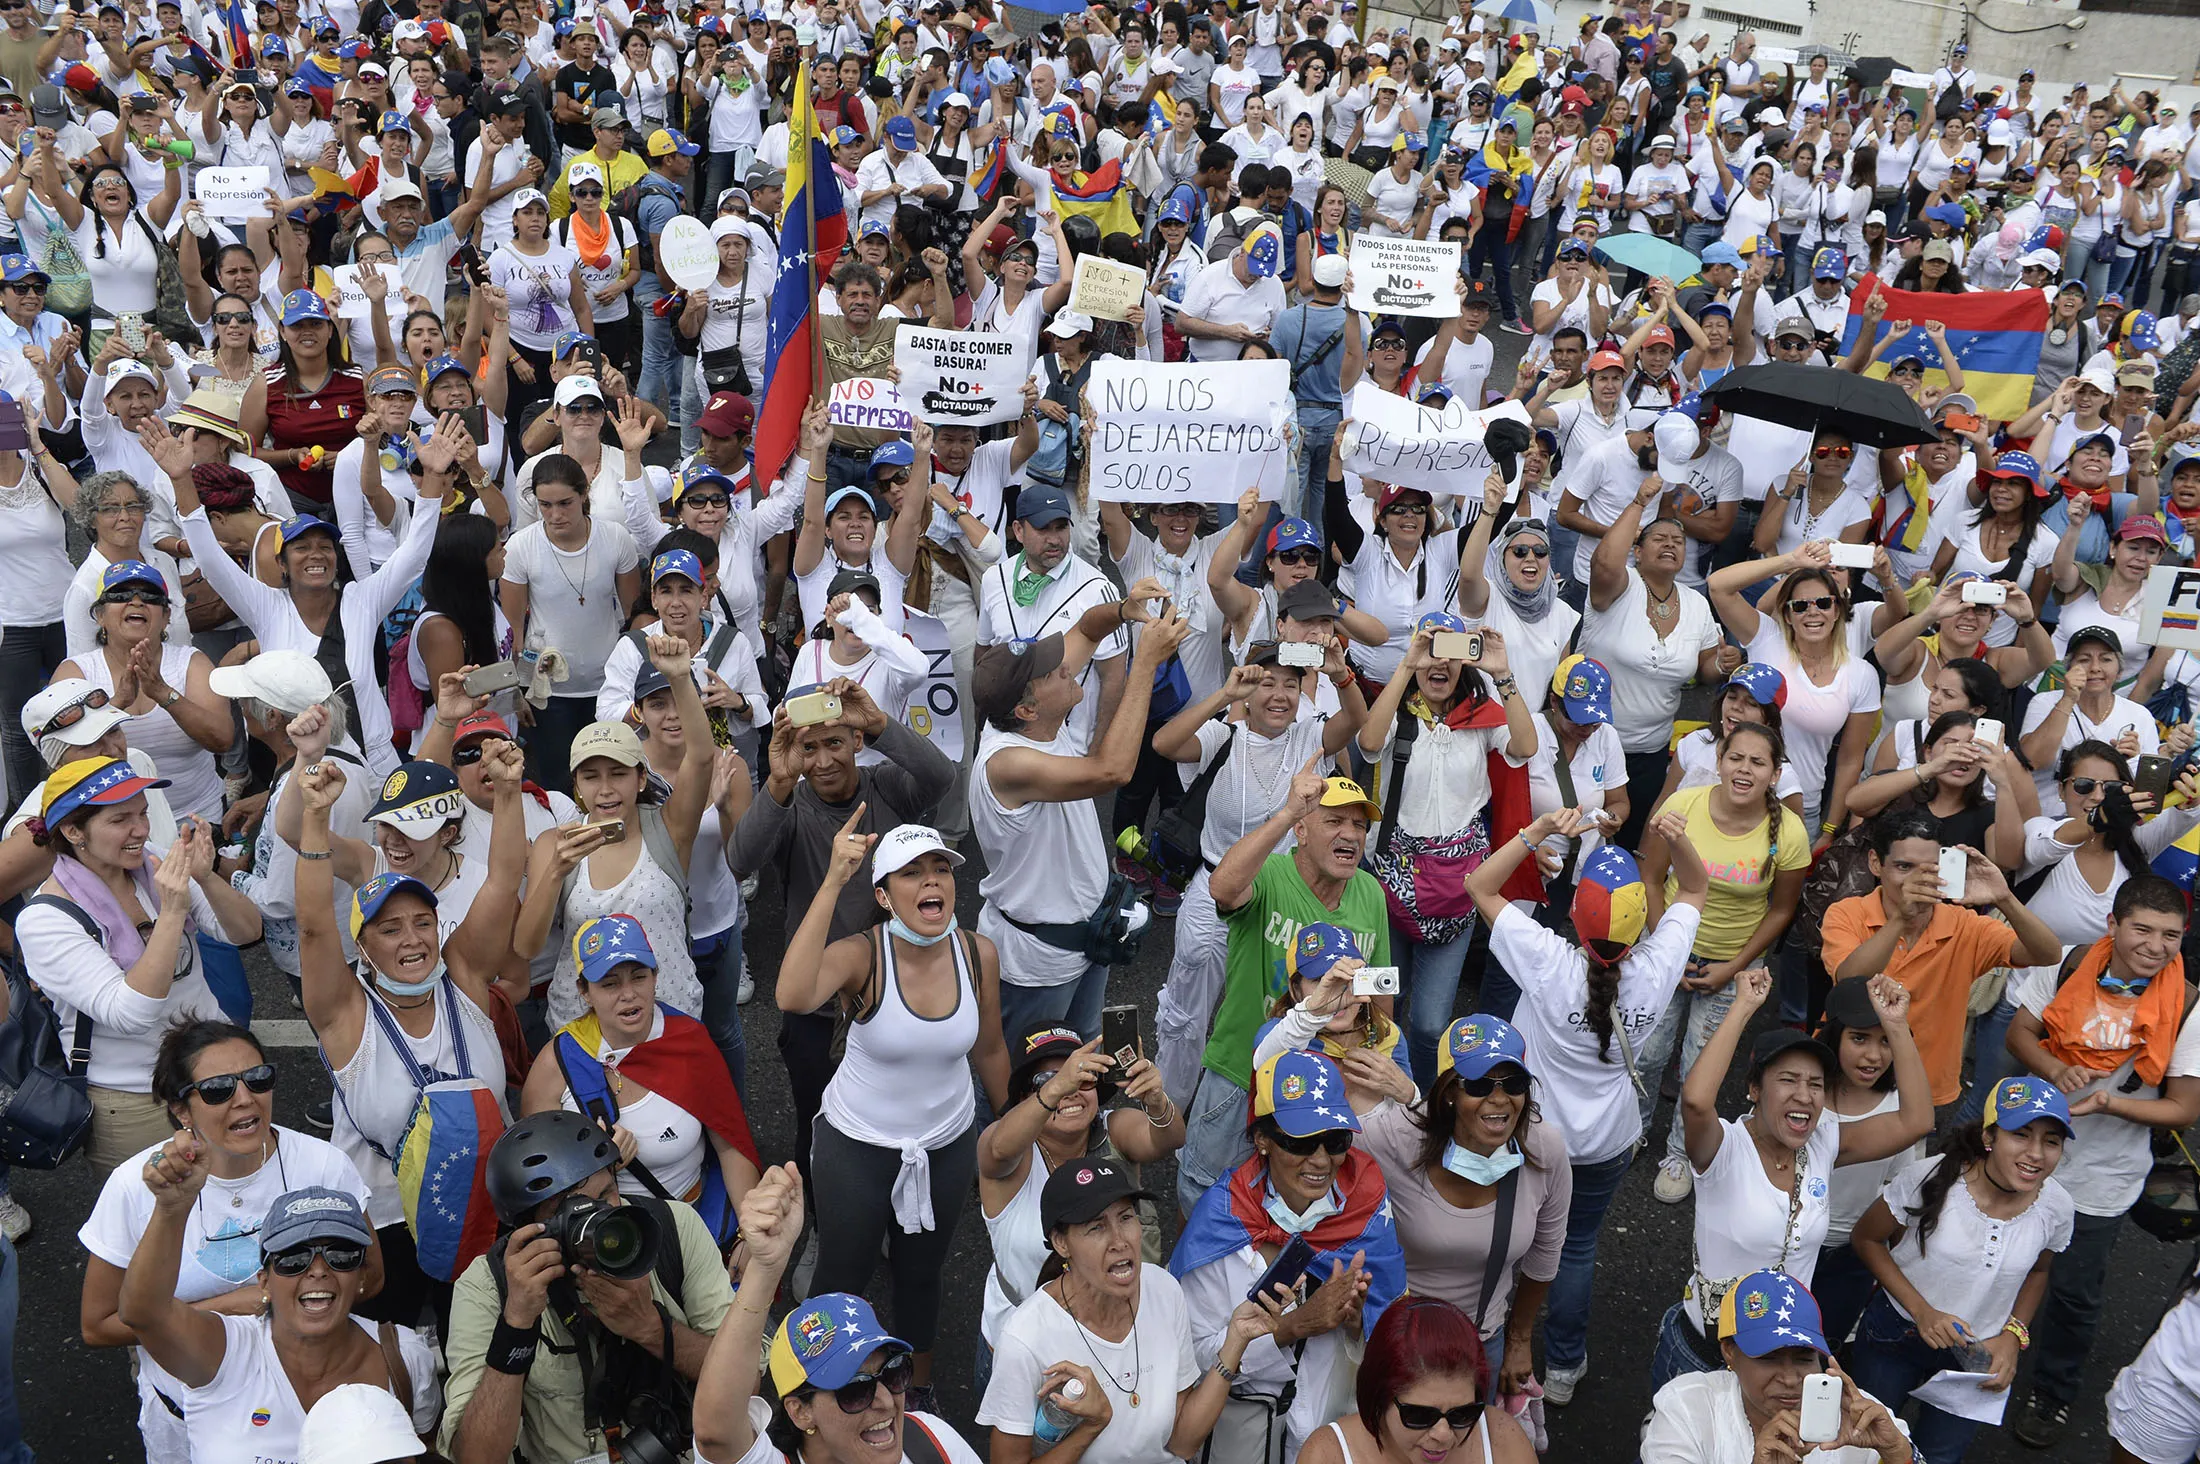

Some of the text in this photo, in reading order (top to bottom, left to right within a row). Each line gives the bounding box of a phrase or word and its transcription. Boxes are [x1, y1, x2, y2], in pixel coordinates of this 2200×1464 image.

[212, 175, 230, 184] No
[203, 189, 265, 201] Represión
[1358, 240, 1454, 255] TODOS LOS ALIMENTOS
[1404, 255, 1431, 263] TODAS
[1085, 265, 1113, 283] NO
[1389, 263, 1439, 272] PERSONAS!
[1380, 294, 1430, 305] DICTADURA
[910, 335, 1013, 355] BASTA DE COMER
[934, 355, 987, 371] BASURA!
[835, 379, 875, 401] NO
[1106, 377, 1214, 413] NO LOS
[931, 399, 990, 412] DICTADURA
[1417, 402, 1463, 434] NO
[1104, 421, 1281, 454] DEJAREMOS
[1103, 463, 1192, 493] SOLOS
[1567, 1010, 1657, 1029] CALES
[1097, 1167, 1114, 1176] LG
[573, 1202, 593, 1212] Canon
